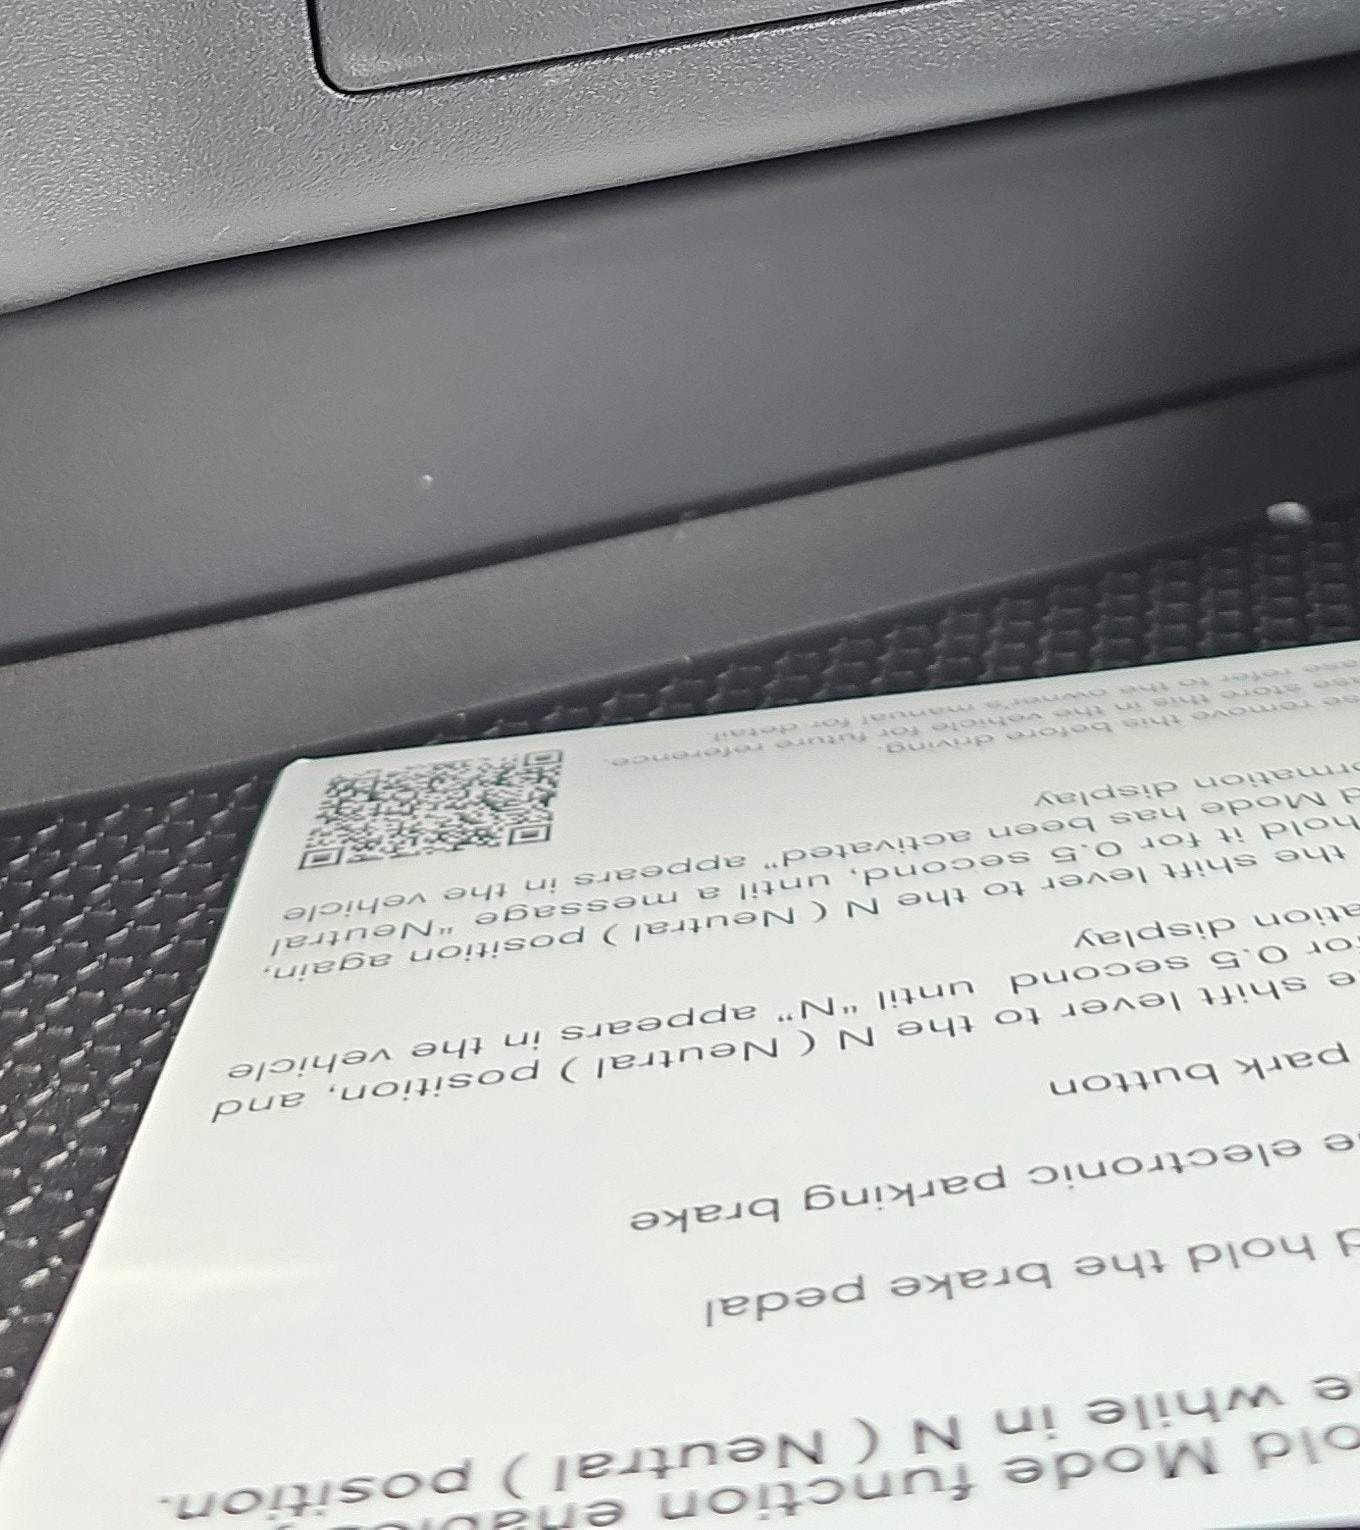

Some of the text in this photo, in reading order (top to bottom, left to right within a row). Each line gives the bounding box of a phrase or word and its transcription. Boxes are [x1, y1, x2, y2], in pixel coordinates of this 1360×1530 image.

[1034, 782, 1178, 807] display
[1201, 792, 1327, 816] Mode
[988, 817, 1096, 839] been
[1109, 807, 1187, 825] has
[1141, 832, 1200, 849] for
[1218, 827, 1244, 844] it
[1050, 842, 1122, 864] 0.5
[1162, 854, 1258, 879] shift
[1275, 845, 1345, 864] the
[574, 855, 746, 886] appears
[850, 852, 1030, 887] second,
[1042, 867, 1148, 890] lever
[443, 883, 506, 902] the
[525, 878, 556, 894] in
[697, 887, 720, 900] a
[740, 874, 830, 901] until
[898, 888, 966, 907] the
[983, 881, 1025, 897] to
[283, 893, 426, 923] vehicle
[475, 891, 677, 925] message
[847, 898, 879, 919] N
[635, 907, 794, 943] Neutral
[1074, 919, 1235, 948] display
[409, 926, 584, 963] position
[1210, 946, 1288, 970] 0.5
[264, 952, 392, 982] again,
[1010, 956, 1189, 995] second
[878, 981, 974, 1011] until
[1062, 992, 1181, 1017] lever
[1201, 977, 1307, 1006] shift
[561, 1003, 756, 1040] appears
[897, 1016, 973, 1038] the
[995, 1008, 1040, 1026] to
[411, 1037, 482, 1060] the
[504, 1031, 540, 1051] in
[839, 1026, 874, 1050] N
[228, 1048, 391, 1082] vehicle
[597, 1038, 778, 1079] Neutral
[1235, 1042, 1350, 1080] park
[329, 1059, 539, 1101] position,
[1050, 1063, 1219, 1096] button
[211, 1092, 305, 1124] and
[1028, 1140, 1302, 1190] electronic
[804, 1164, 1006, 1211] parking
[630, 1198, 780, 1234] brake
[1074, 1250, 1166, 1279] the
[1187, 1234, 1316, 1273] hold
[890, 1263, 1053, 1301] brake
[706, 1274, 865, 1328] pedal
[1086, 1384, 1285, 1430] while
[912, 1416, 962, 1454] N
[994, 1405, 1056, 1440] in
[554, 1430, 825, 1492] Neutral
[1003, 1438, 1220, 1490] Mode
[159, 1459, 472, 1520] position.
[658, 1463, 976, 1521] function
